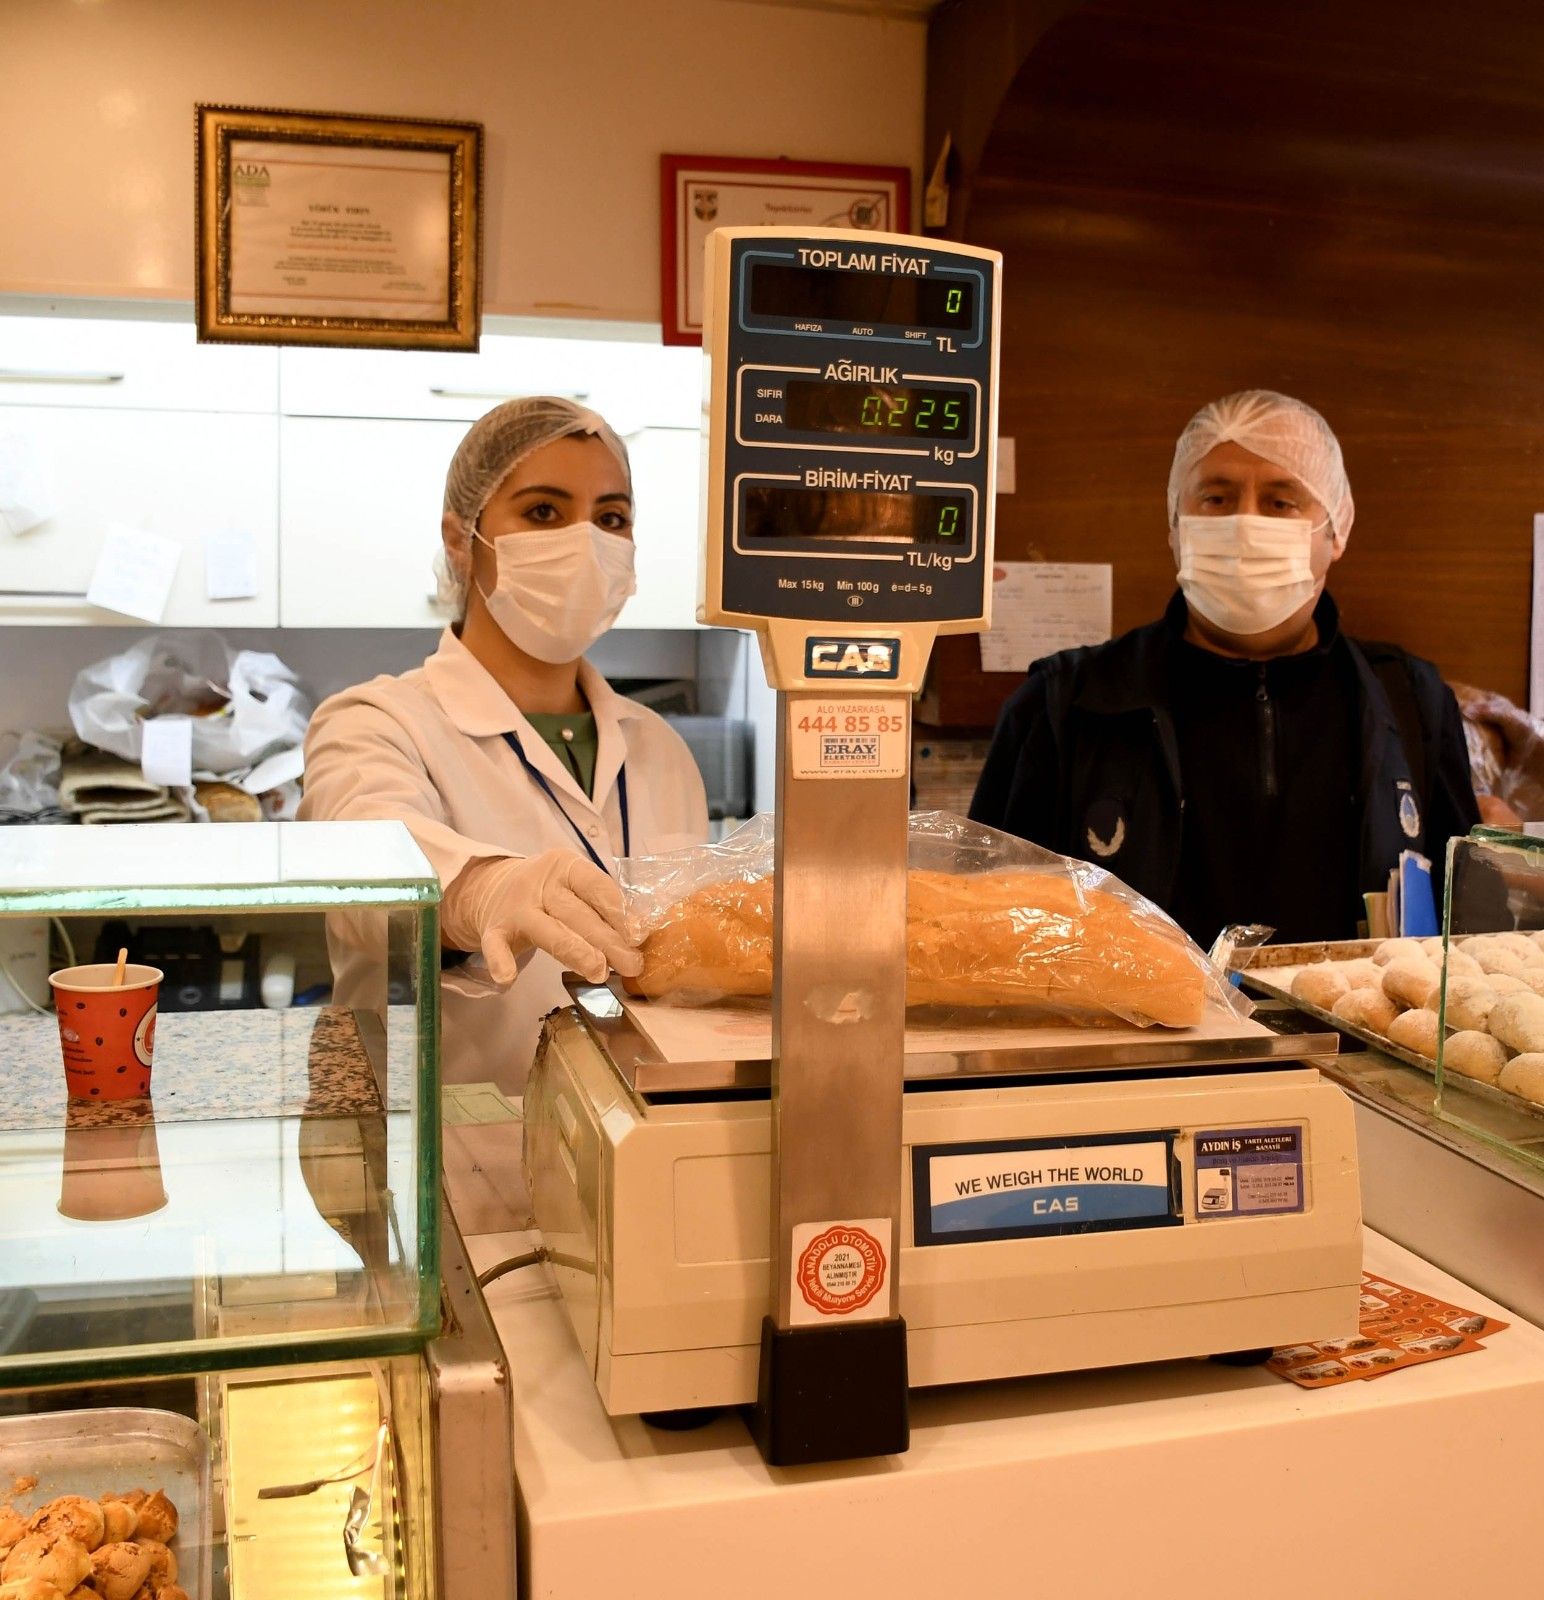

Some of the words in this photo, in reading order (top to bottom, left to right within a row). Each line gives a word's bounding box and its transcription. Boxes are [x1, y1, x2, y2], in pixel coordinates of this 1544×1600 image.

[233, 164, 270, 177] ADA
[798, 249, 876, 272] TOPLAM
[881, 253, 930, 276] FİYAT
[946, 289, 962, 313] 0
[795, 323, 823, 332] HAFIZA
[852, 327, 874, 336] AUTO
[905, 331, 927, 340] SHIFT
[936, 336, 957, 353] TL
[824, 359, 898, 384] AĞIRLIK
[757, 389, 783, 399] SIFIR
[755, 413, 783, 424] DARA
[861, 396, 961, 430] 0.225
[934, 447, 954, 465] kg
[805, 467, 912, 491] BİRİM-FİYAT
[938, 506, 959, 535] 0
[907, 552, 952, 571] TL/kg
[778, 579, 797, 589] Max
[837, 581, 854, 591] Min
[817, 705, 834, 714] ALO
[836, 705, 886, 714] YAZARKASA
[798, 716, 837, 733] 444
[845, 716, 870, 733] 85
[877, 716, 903, 733] 85
[824, 744, 876, 755] ERAY
[1201, 1141, 1230, 1152] AYDIN
[1232, 1138, 1241, 1152] İŞ
[955, 1178, 983, 1196] WE
[987, 1170, 1042, 1190] WEIGH
[1047, 1167, 1080, 1183] THE
[1085, 1167, 1144, 1182] WORLD
[1033, 1197, 1079, 1215] CAS
[807, 1234, 838, 1275] ANADOLU
[834, 1253, 850, 1262] 2021
